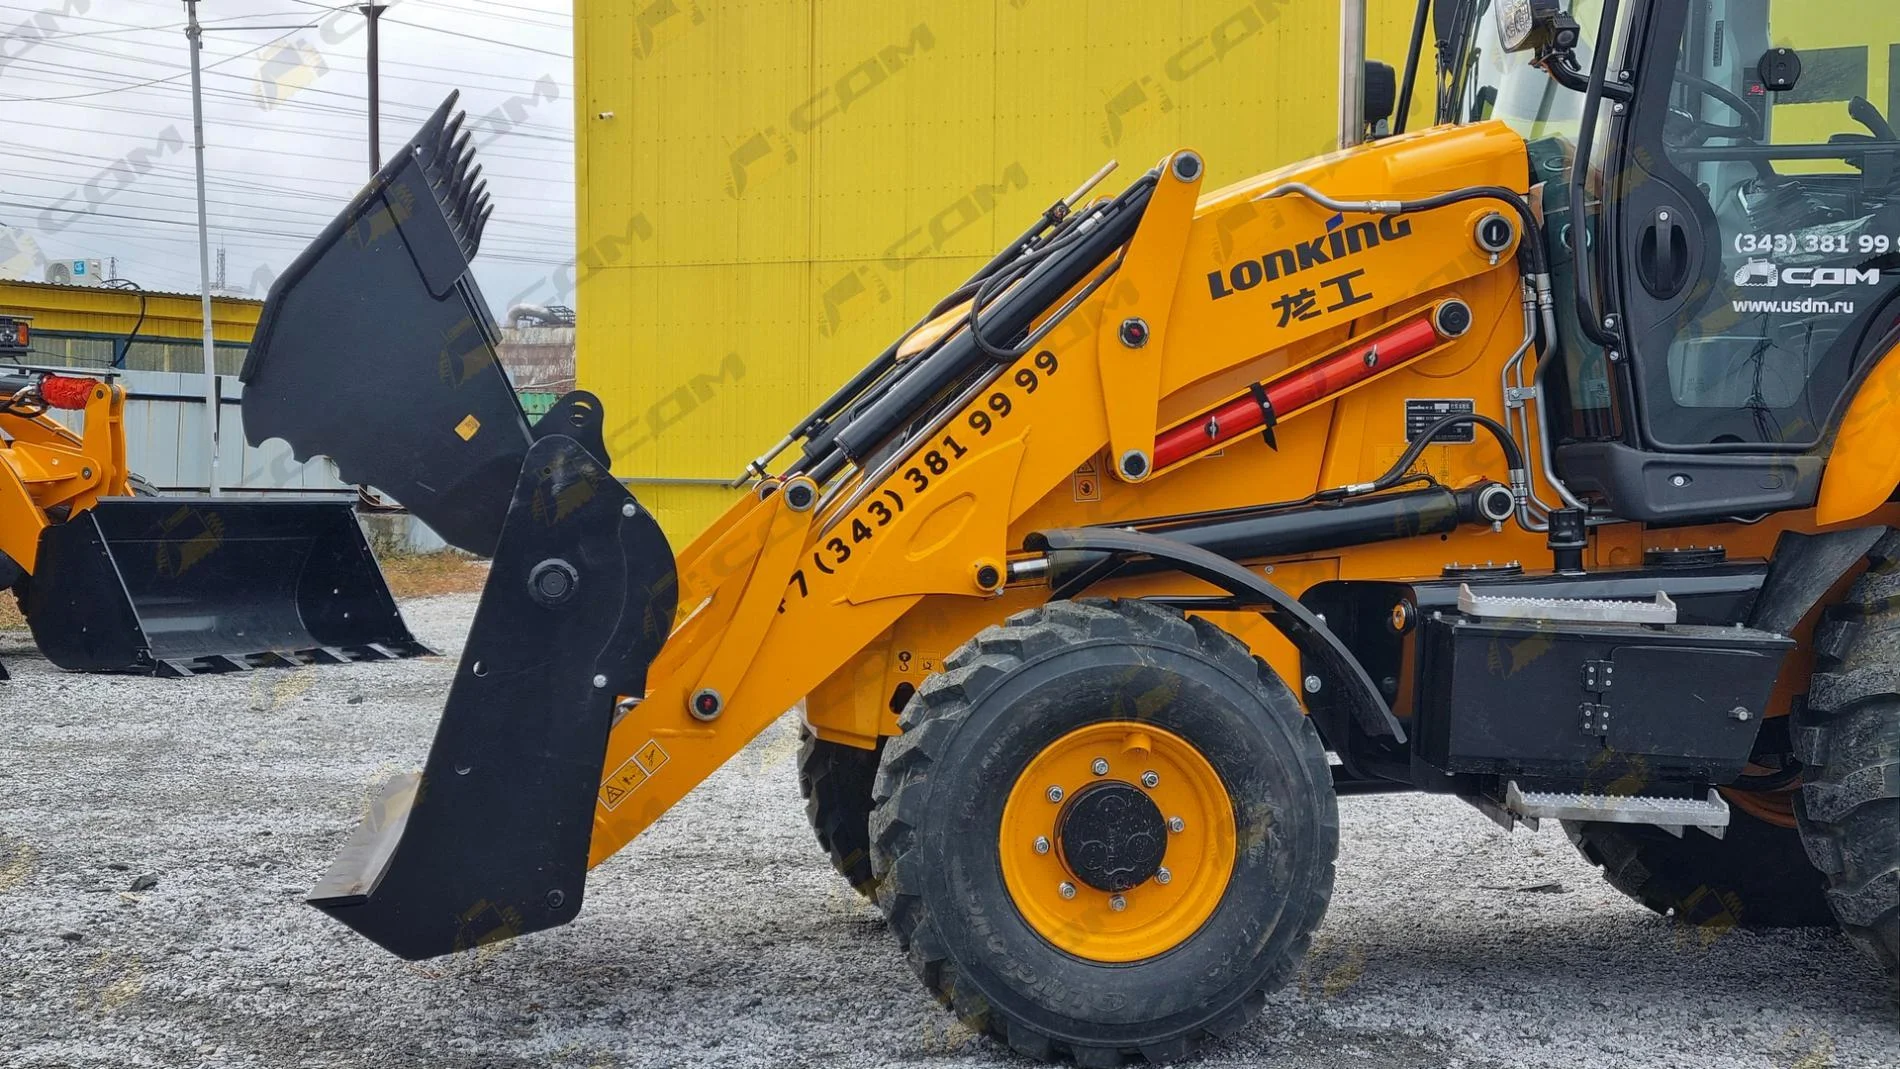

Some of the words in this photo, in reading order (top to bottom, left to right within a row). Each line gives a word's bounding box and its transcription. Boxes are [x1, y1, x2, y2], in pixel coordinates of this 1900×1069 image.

[1734, 233, 1797, 253] (343)
[1805, 235, 1849, 253] 381
[1858, 234, 1890, 253] 99
[1732, 298, 1854, 313] www.usdm.ru
[813, 489, 904, 574] (343)
[904, 435, 968, 493] 381
[968, 392, 1012, 436] 99
[1015, 350, 1059, 394] 99
